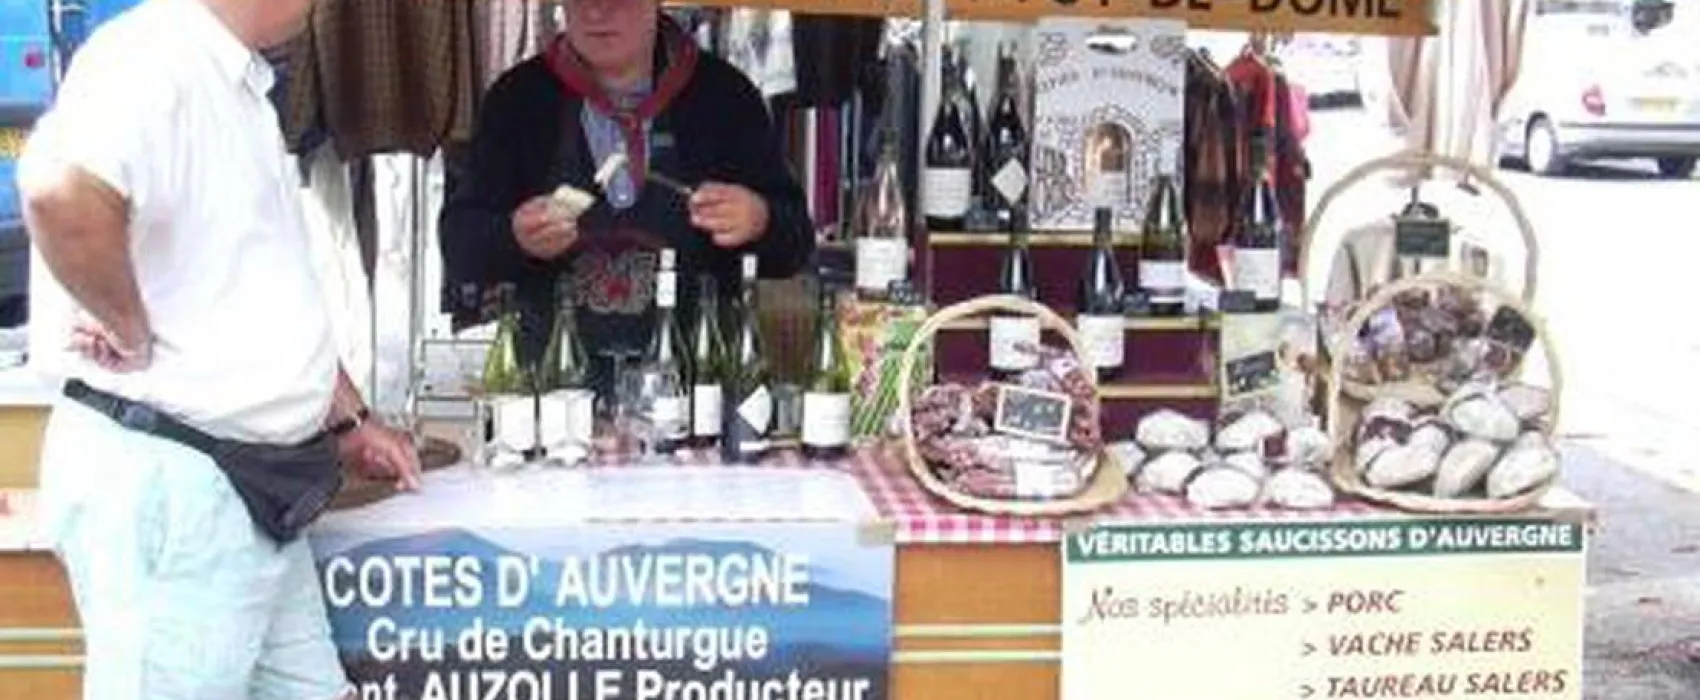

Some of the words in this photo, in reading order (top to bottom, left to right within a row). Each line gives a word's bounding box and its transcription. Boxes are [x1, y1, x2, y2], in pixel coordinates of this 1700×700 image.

[1077, 528, 1231, 556] VÉRITABLES
[1239, 526, 1401, 553] SAUCISSONS
[1409, 523, 1573, 549] D'AUVERGNE
[325, 555, 483, 607] COTES
[497, 554, 540, 607] D'
[556, 553, 810, 607] AUVERGNE
[1079, 587, 1139, 624] Nos
[1327, 588, 1405, 614] PORC
[367, 616, 444, 662] Cru
[457, 616, 509, 661] de
[523, 616, 770, 672] Chanturgue
[1328, 631, 1423, 657] VACHE
[1430, 627, 1534, 654] SALERS
[635, 669, 870, 700] Producteur
[1326, 673, 1458, 699] TAUREAU
[1464, 669, 1570, 696] SALERS
